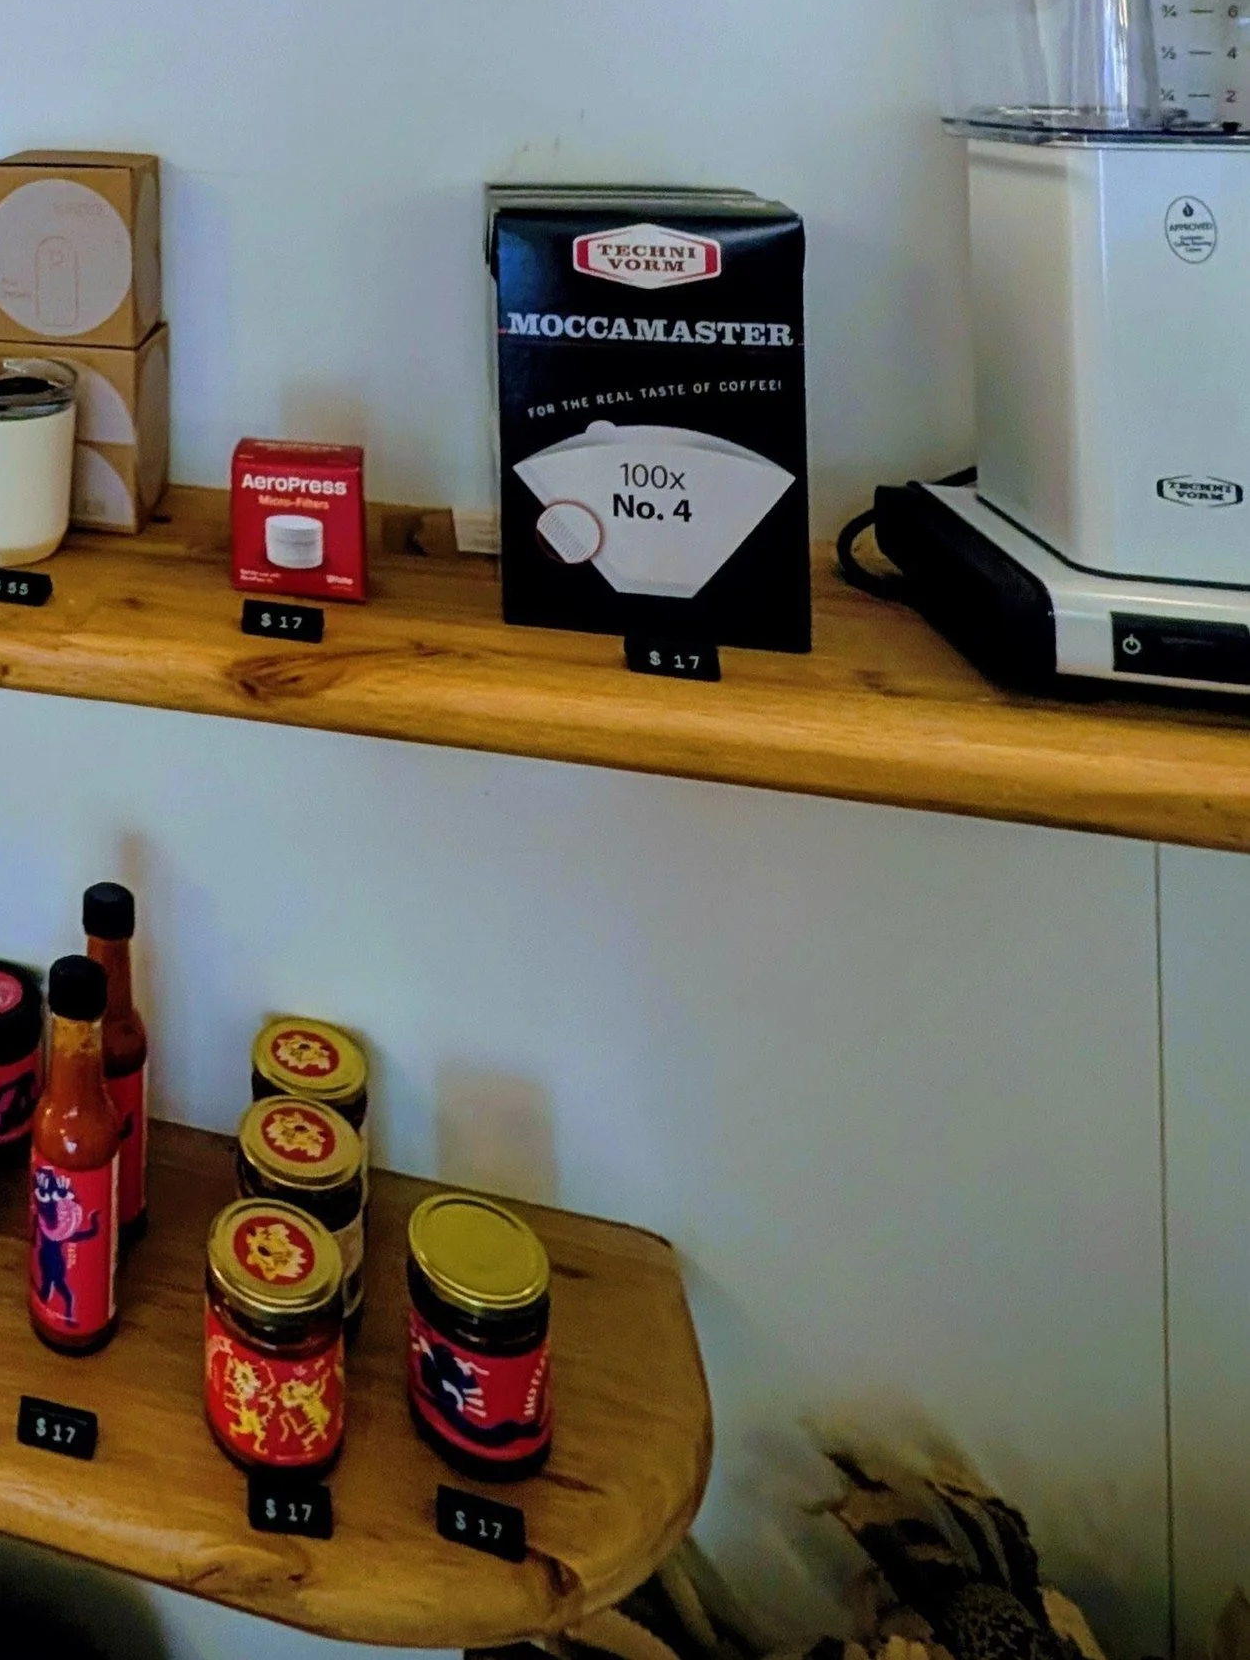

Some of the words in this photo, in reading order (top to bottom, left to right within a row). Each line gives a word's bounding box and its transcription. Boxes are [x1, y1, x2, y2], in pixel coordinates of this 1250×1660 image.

[1227, 4, 1239, 18] 6
[1226, 46, 1238, 60] 4
[1225, 90, 1236, 103] 2
[596, 243, 697, 260] TECHNI
[608, 258, 687, 274] VORM
[507, 311, 794, 347] MOCCAMASTER
[527, 402, 556, 420] FOR
[561, 395, 590, 412] THE
[596, 390, 634, 408] REAL
[638, 381, 686, 399] TASTE
[692, 380, 711, 395] OF
[241, 472, 348, 497] AeroPress
[619, 462, 686, 492] 100x
[1176, 490, 1225, 501] VORM
[612, 492, 665, 521] No.
[672, 499, 693, 522] 4
